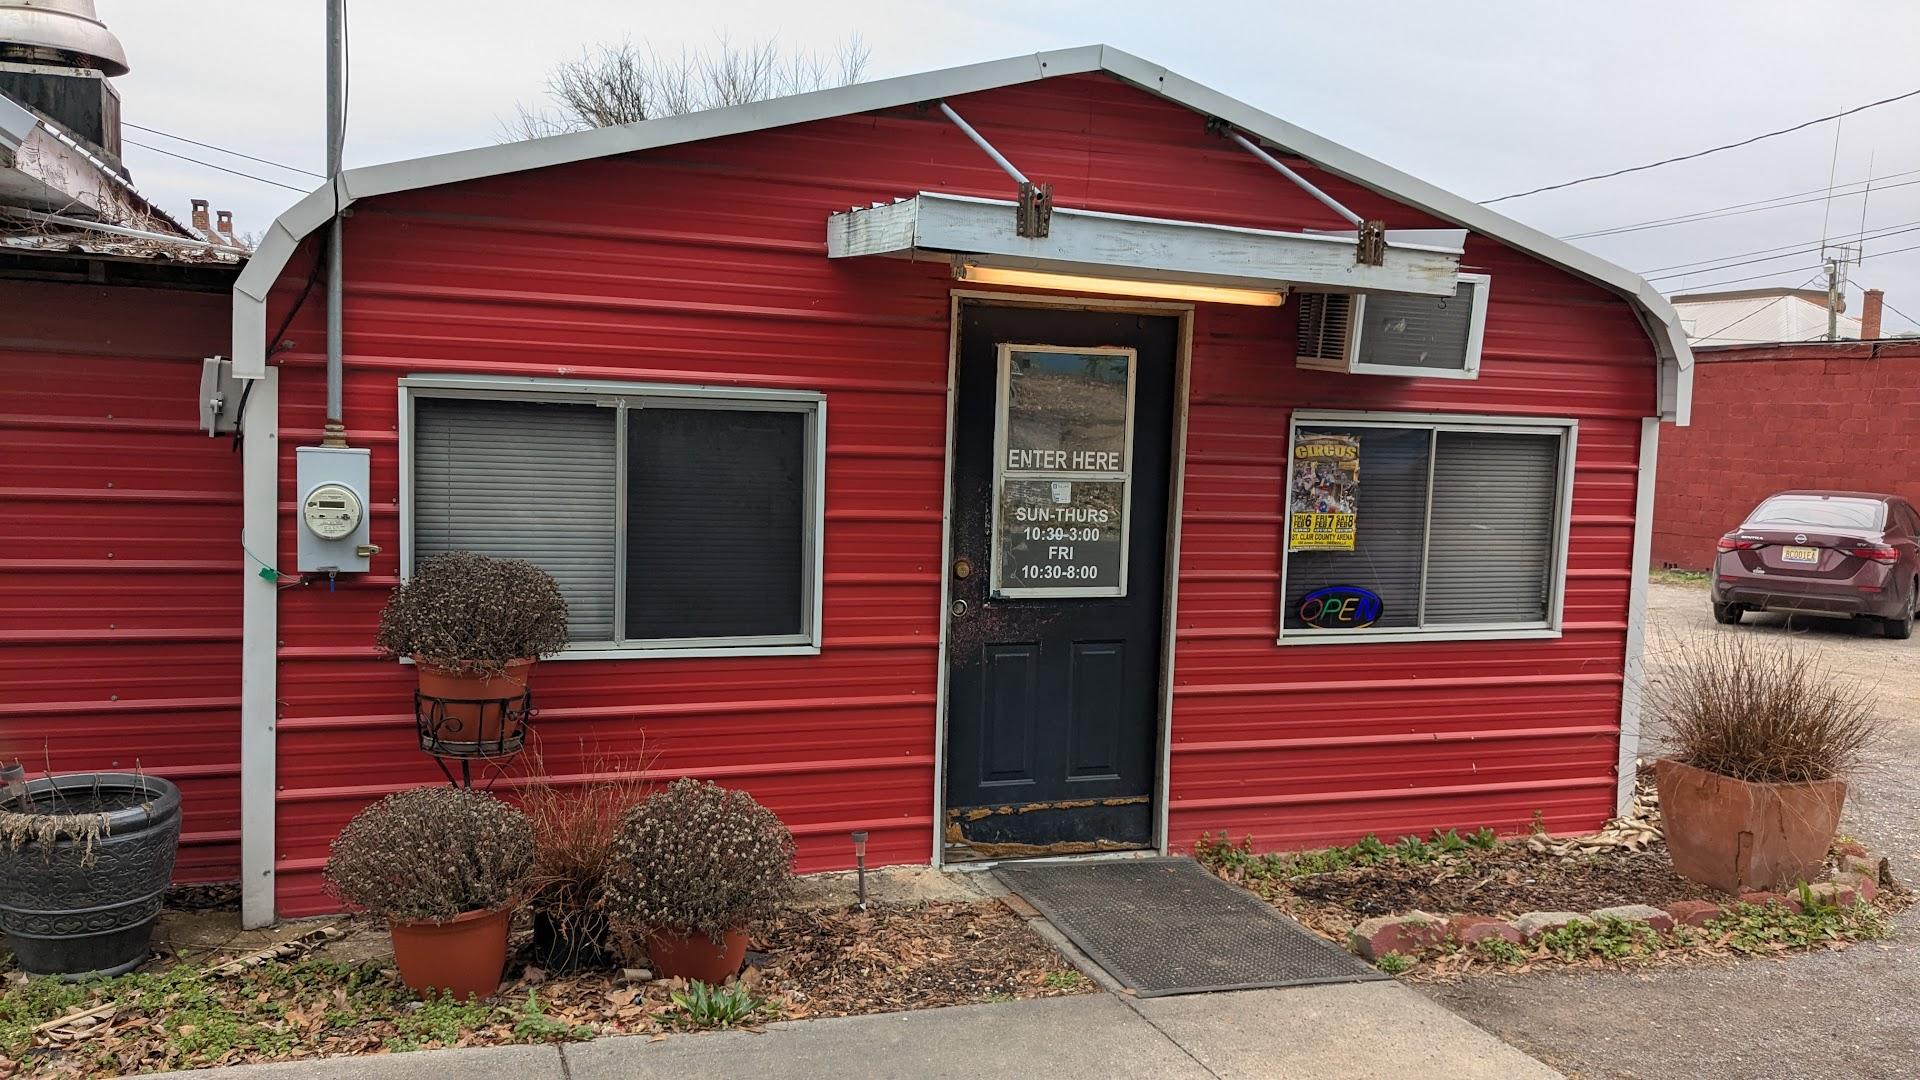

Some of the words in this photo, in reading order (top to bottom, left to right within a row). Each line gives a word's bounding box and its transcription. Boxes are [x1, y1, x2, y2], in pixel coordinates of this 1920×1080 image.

[1295, 445, 1357, 459] CIRCUS
[1008, 449, 1067, 469] ENTER
[1072, 451, 1119, 470] HERE
[1016, 507, 1109, 523] SUN-THURS
[1305, 515, 1312, 527] 6
[1328, 515, 1335, 528] 7
[1347, 515, 1354, 528] 8
[1023, 527, 1100, 542] 10:30-3:00
[1048, 546, 1074, 560] FRI
[1021, 565, 1098, 579] 10:30-8:00
[1300, 597, 1380, 622] OPEN
